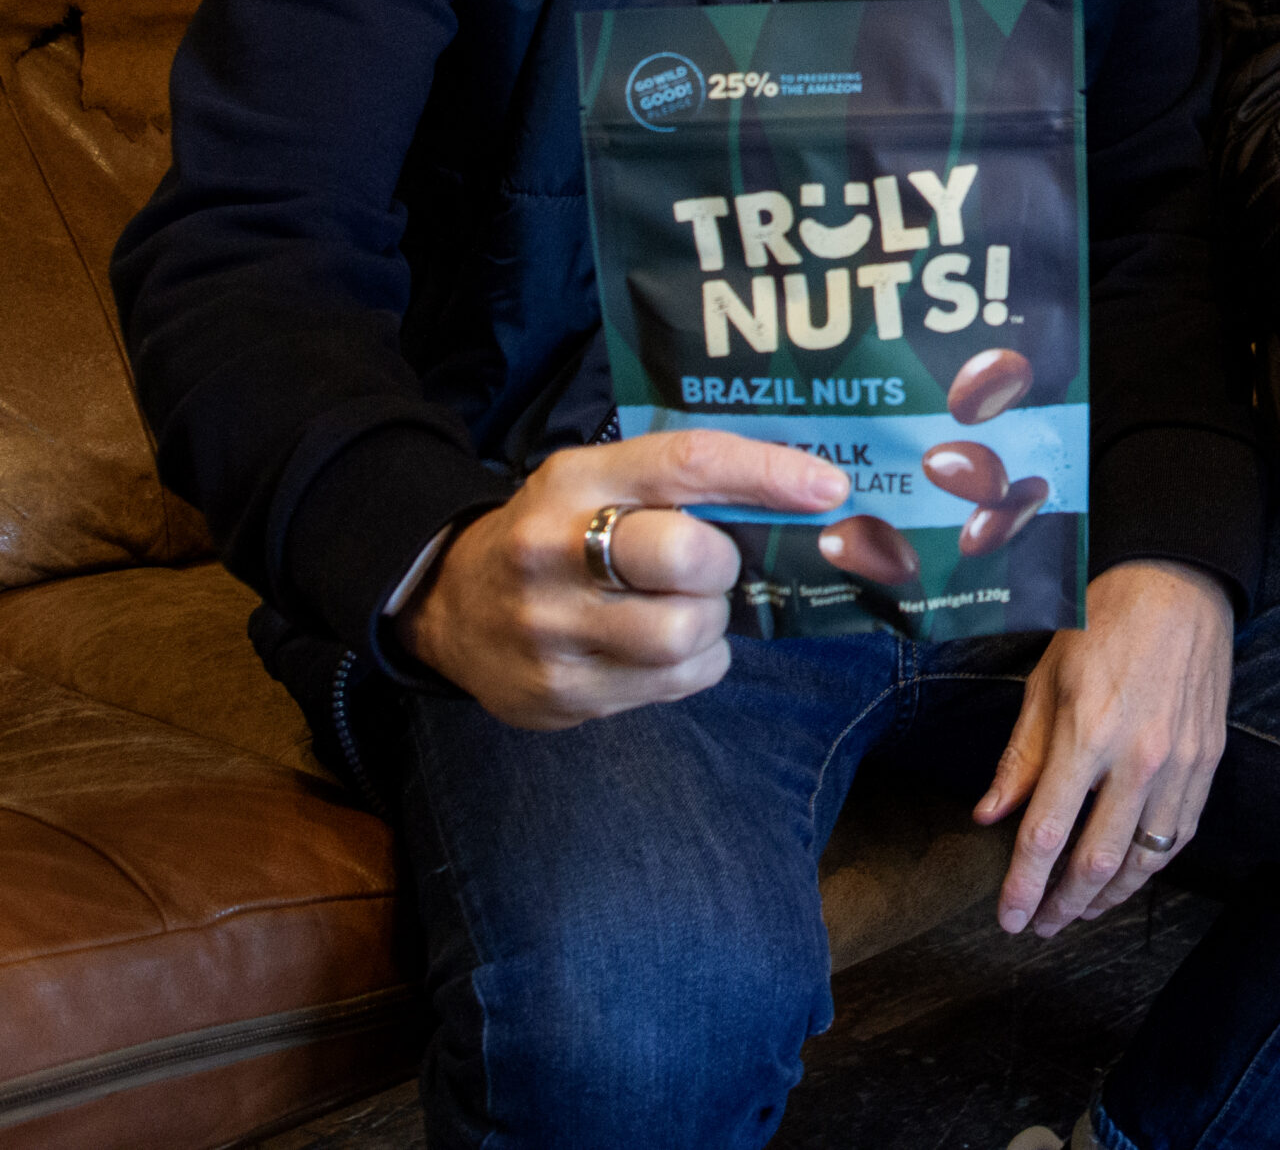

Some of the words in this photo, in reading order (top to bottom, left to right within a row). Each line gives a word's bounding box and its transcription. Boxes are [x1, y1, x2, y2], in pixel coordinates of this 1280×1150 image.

[708, 71, 779, 99] 25%
[780, 83, 805, 96] THE
[806, 82, 863, 95] AMAZON
[703, 245, 1010, 358] NUTS!
[681, 376, 806, 405] BRAZIL
[812, 376, 906, 406] NUTS
[849, 472, 913, 495] LATE
[977, 587, 1011, 604] 120g
